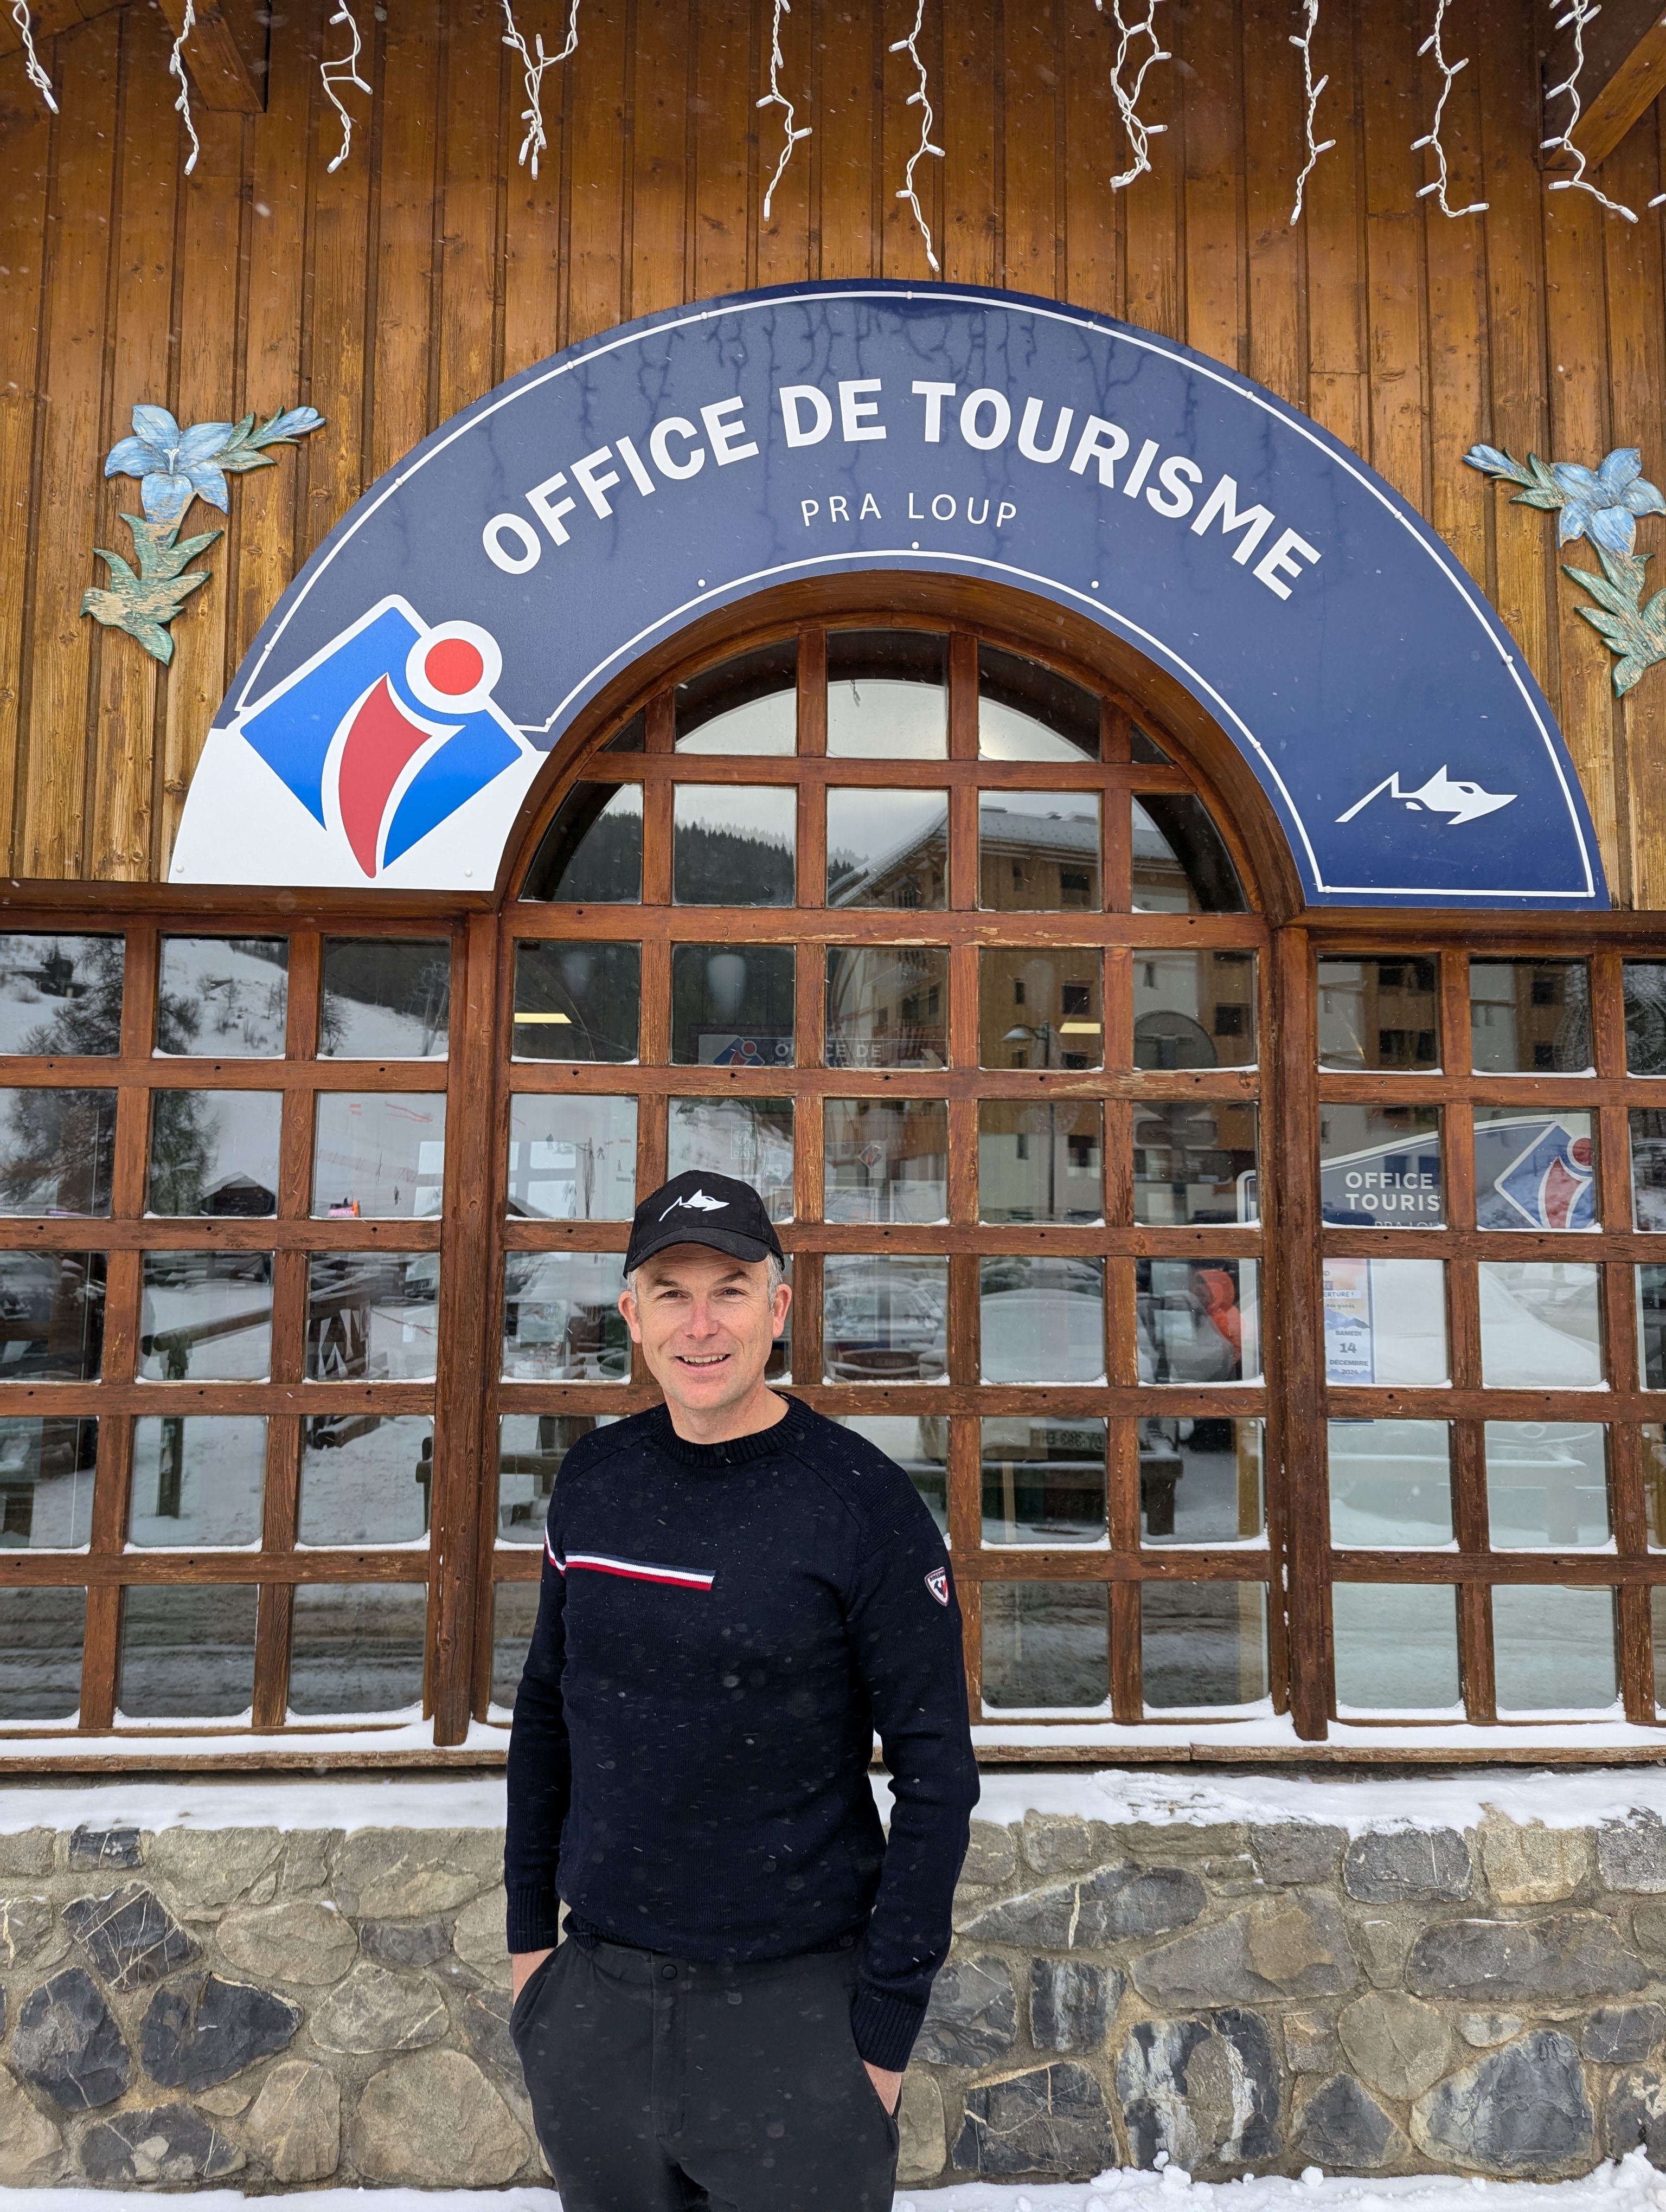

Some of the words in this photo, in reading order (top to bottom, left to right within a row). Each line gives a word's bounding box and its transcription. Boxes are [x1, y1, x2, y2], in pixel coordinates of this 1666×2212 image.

[482, 395, 759, 575] OFFICE
[778, 378, 887, 448] DE
[911, 380, 1322, 601] TOURISME
[800, 493, 882, 526] PRA
[908, 492, 1017, 528] LOUP
[857, 1044, 881, 1058] DE
[1345, 1172, 1433, 1189] OFFICE
[1340, 1342, 1357, 1353] 14
